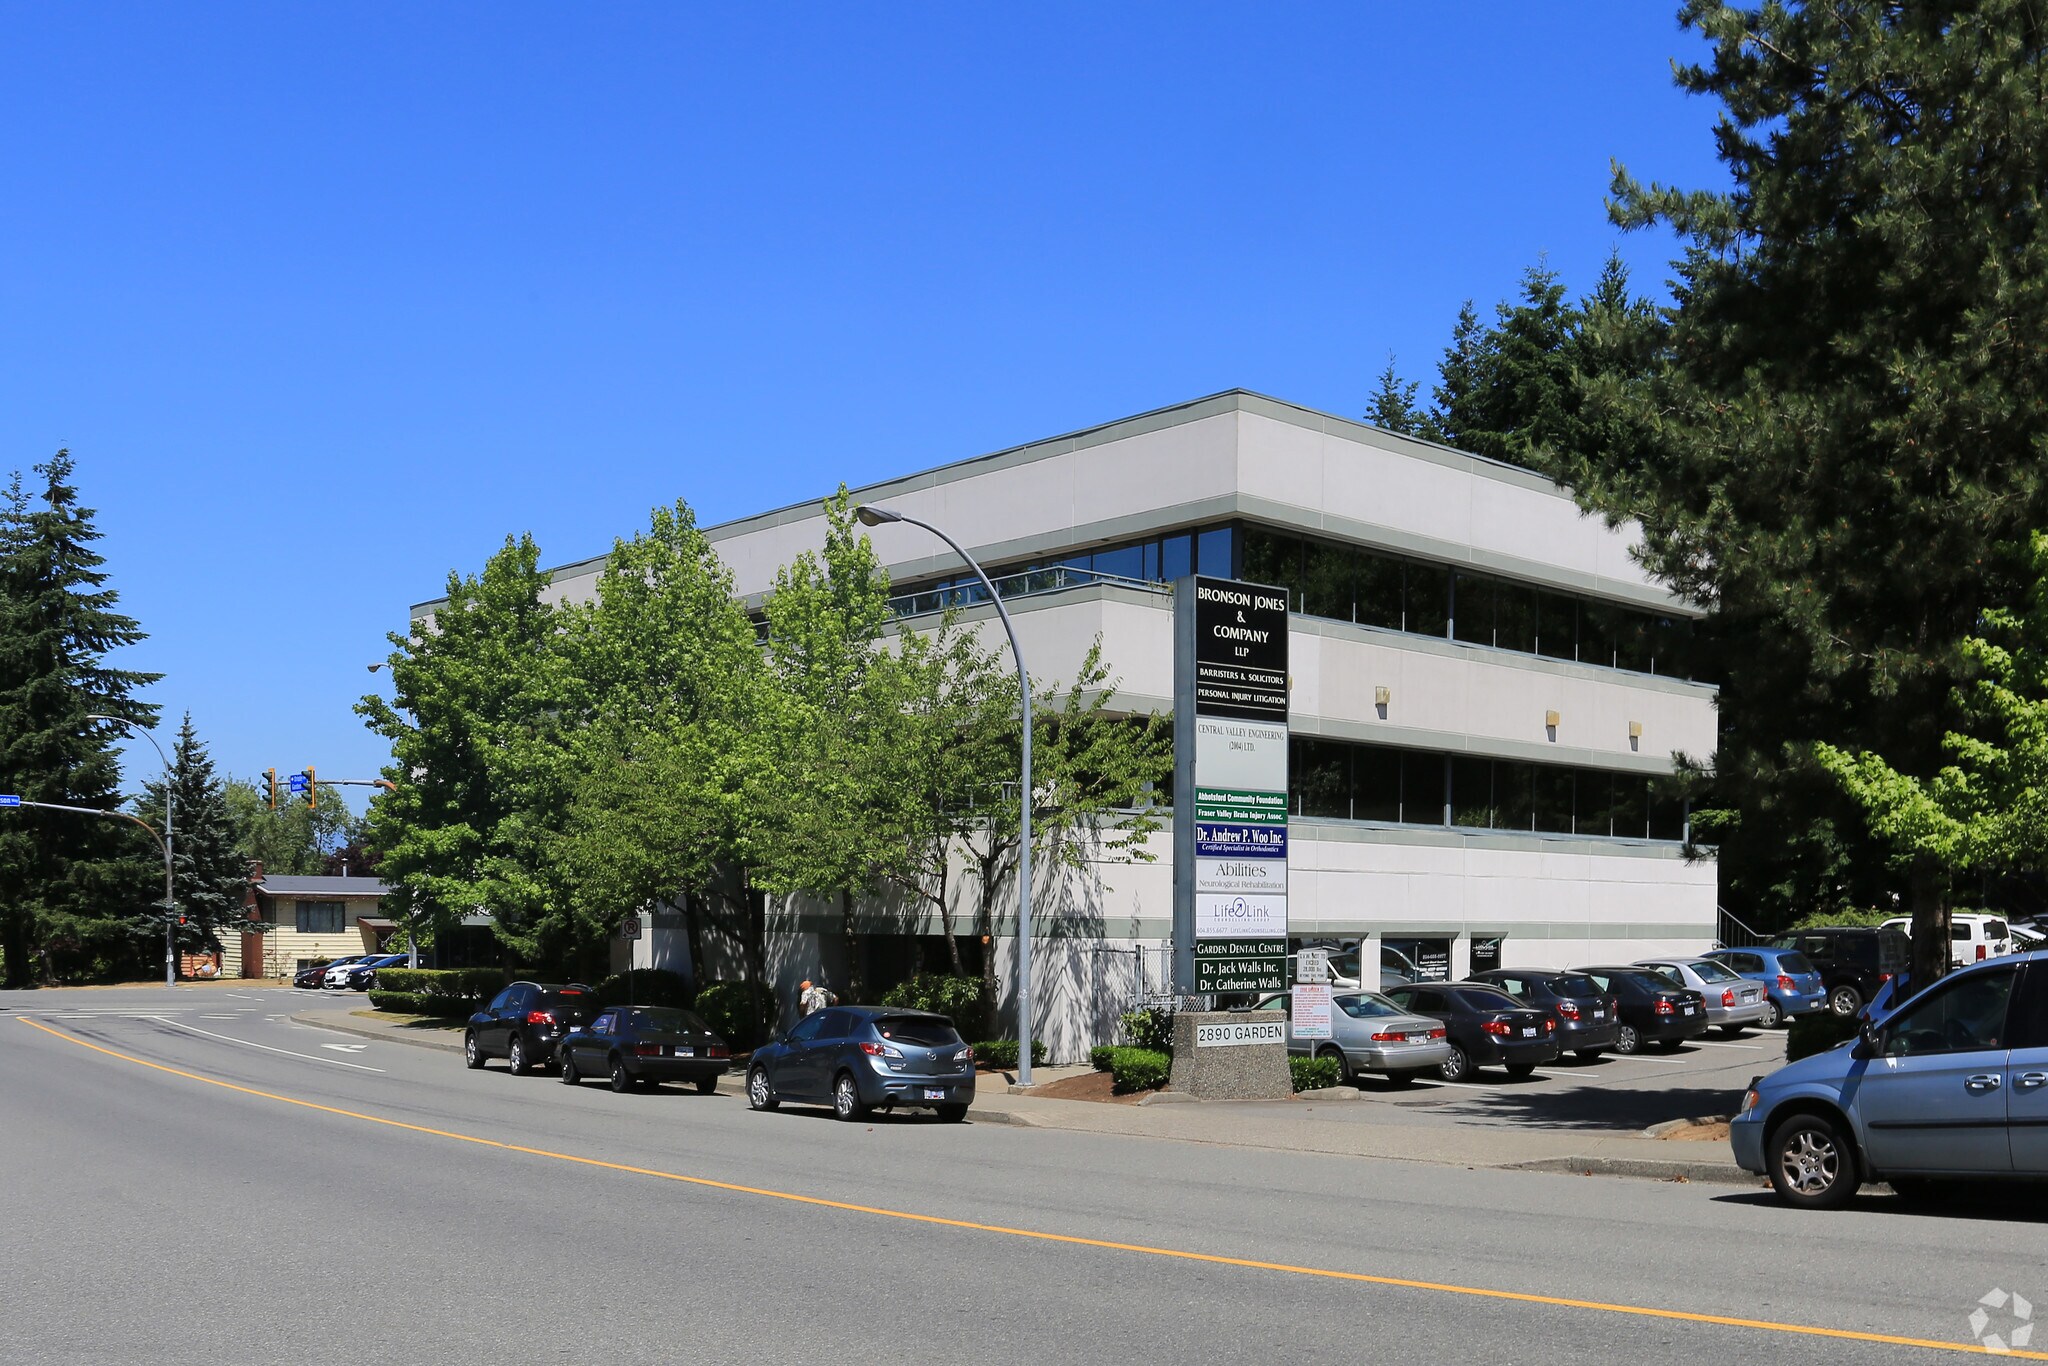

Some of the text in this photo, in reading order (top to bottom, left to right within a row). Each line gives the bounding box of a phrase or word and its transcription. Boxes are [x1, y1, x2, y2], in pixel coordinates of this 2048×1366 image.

[1198, 587, 1284, 611] BRONSON JONES
[1237, 611, 1246, 623] &
[1214, 625, 1269, 643] COMPANY
[1235, 646, 1249, 657] LLP
[1200, 668, 1238, 679] BARRISTERS
[1249, 674, 1283, 684] SOLICITORS
[1198, 689, 1285, 704] PERSONAL INJURY LITIGATION
[1198, 724, 1284, 740] CENTRAL VALLEY ENGINEERING
[1244, 742, 1255, 751] LTD.
[1198, 792, 1283, 804] Abbotsford Community Foundation
[1217, 810, 1232, 819] Valley
[1250, 812, 1266, 820] Injury
[1197, 827, 1284, 844] Dr. Andrew P. Woo Inc.
[1216, 862, 1267, 877] Abilities
[1199, 880, 1240, 889] Neurological
[1214, 904, 1270, 917] Life Link
[1197, 943, 1284, 954] GARDEN DENTAL CENTRE
[1202, 961, 1279, 976] Dr. Jack Walls Inc.
[1200, 977, 1281, 990] Dr. Catherine Walls
[1199, 1028, 1230, 1041] 2890
[1235, 1026, 1282, 1040] GARDEN
